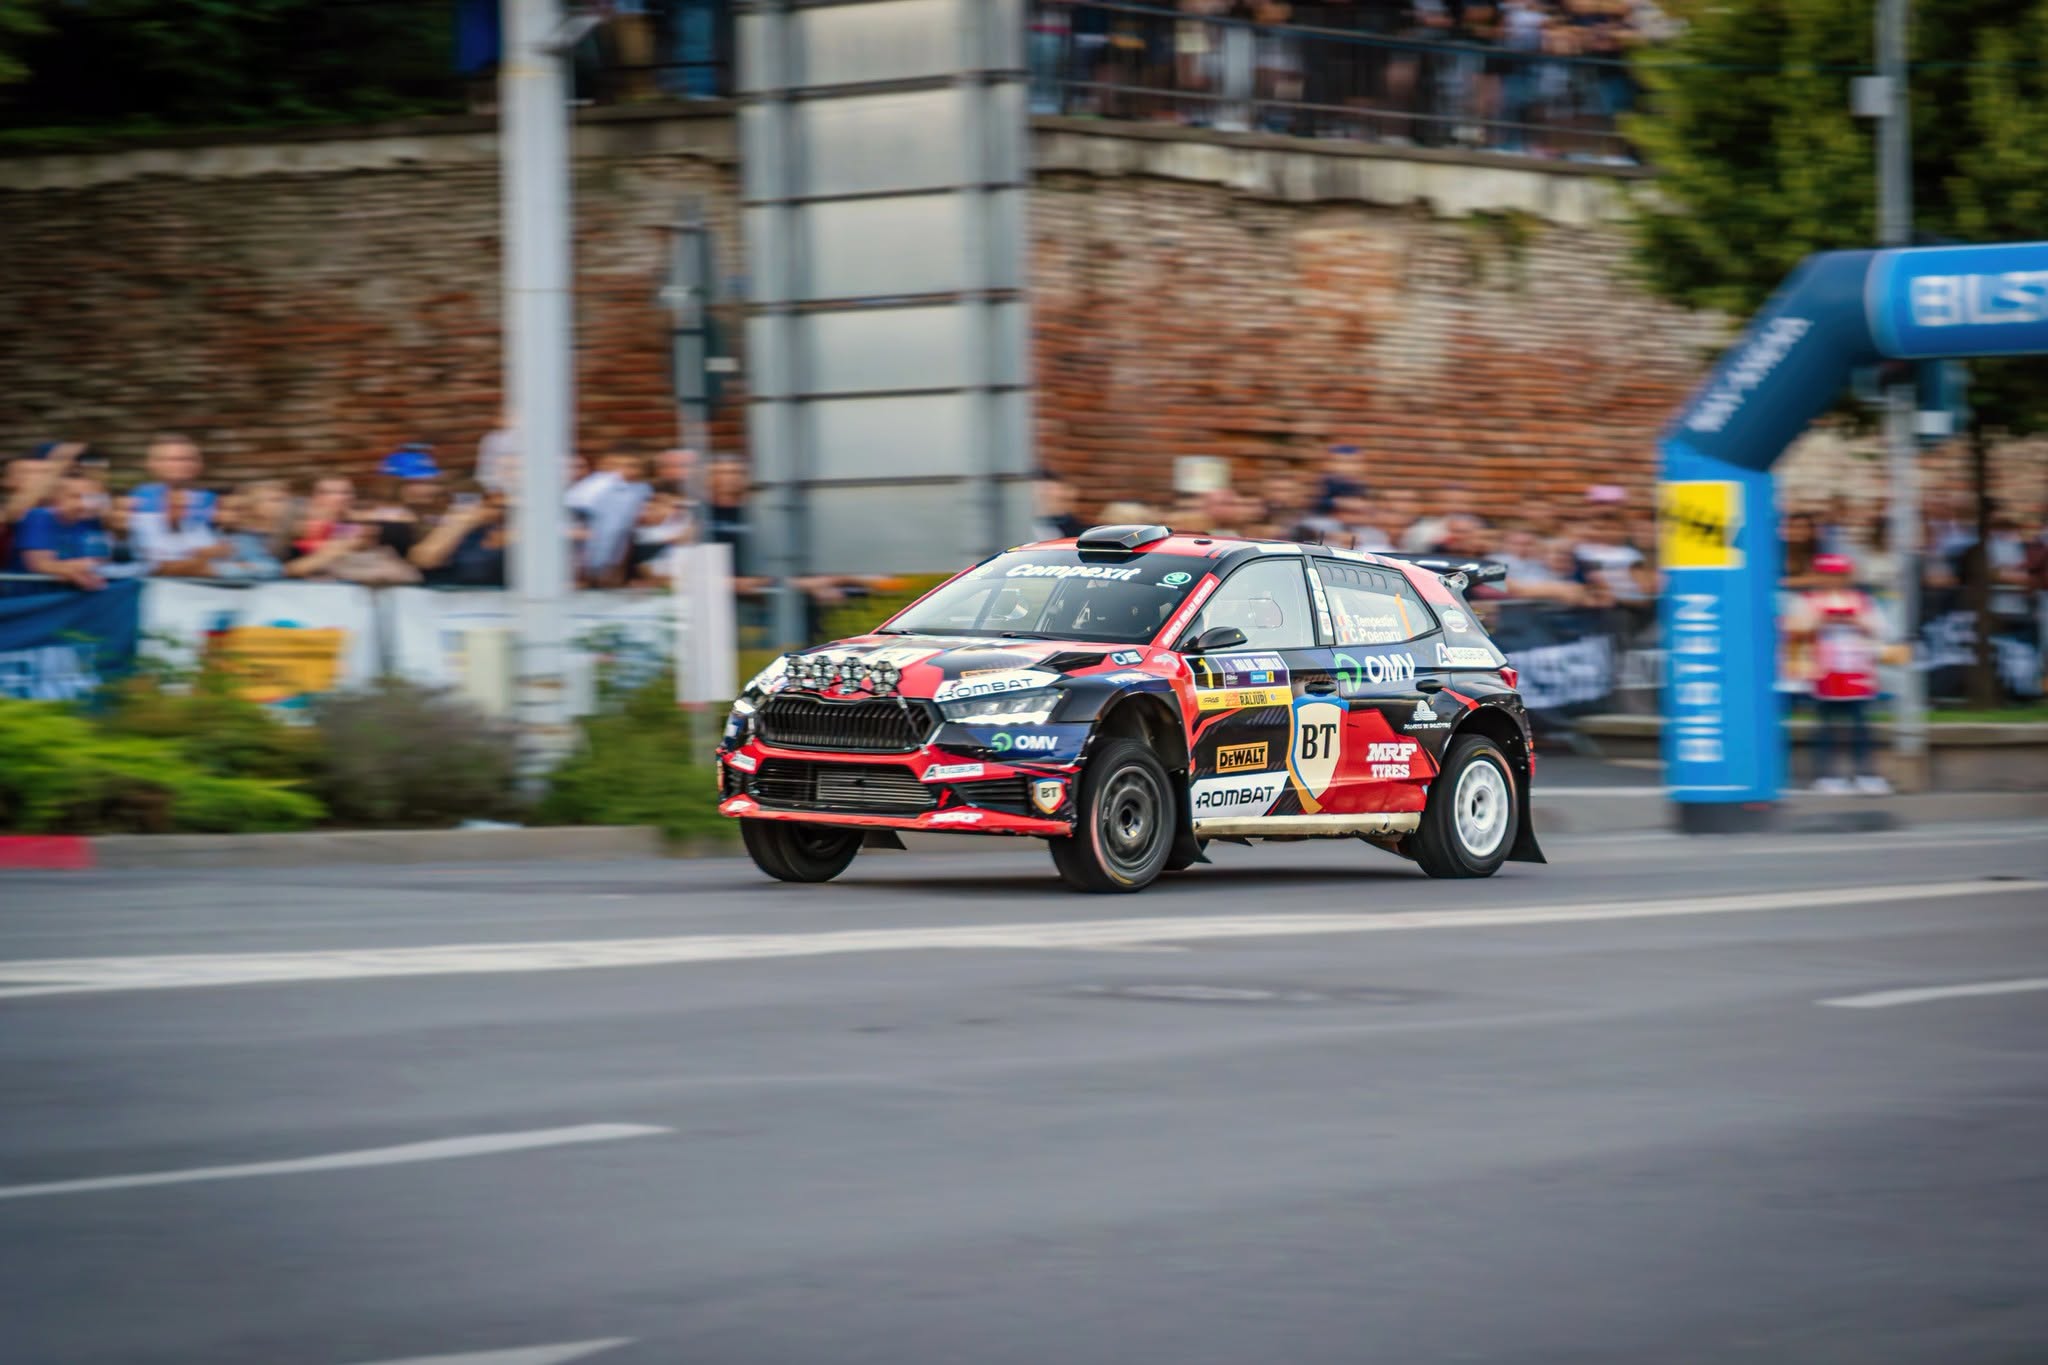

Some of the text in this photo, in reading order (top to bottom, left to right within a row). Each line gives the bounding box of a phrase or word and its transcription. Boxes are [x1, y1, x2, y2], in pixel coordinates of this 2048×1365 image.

[1006, 563, 1142, 580] Compexit
[1197, 658, 1214, 689] 1
[1365, 653, 1415, 684] OMV
[937, 677, 1033, 699] ROMBAT
[1239, 693, 1268, 706] RALIURI
[1015, 735, 1059, 750] OMV
[1301, 722, 1337, 760] BT
[1366, 743, 1417, 762] MRF
[1371, 763, 1410, 778] TYRES
[1041, 786, 1059, 799] BT
[1195, 786, 1275, 809] ROMBAT
